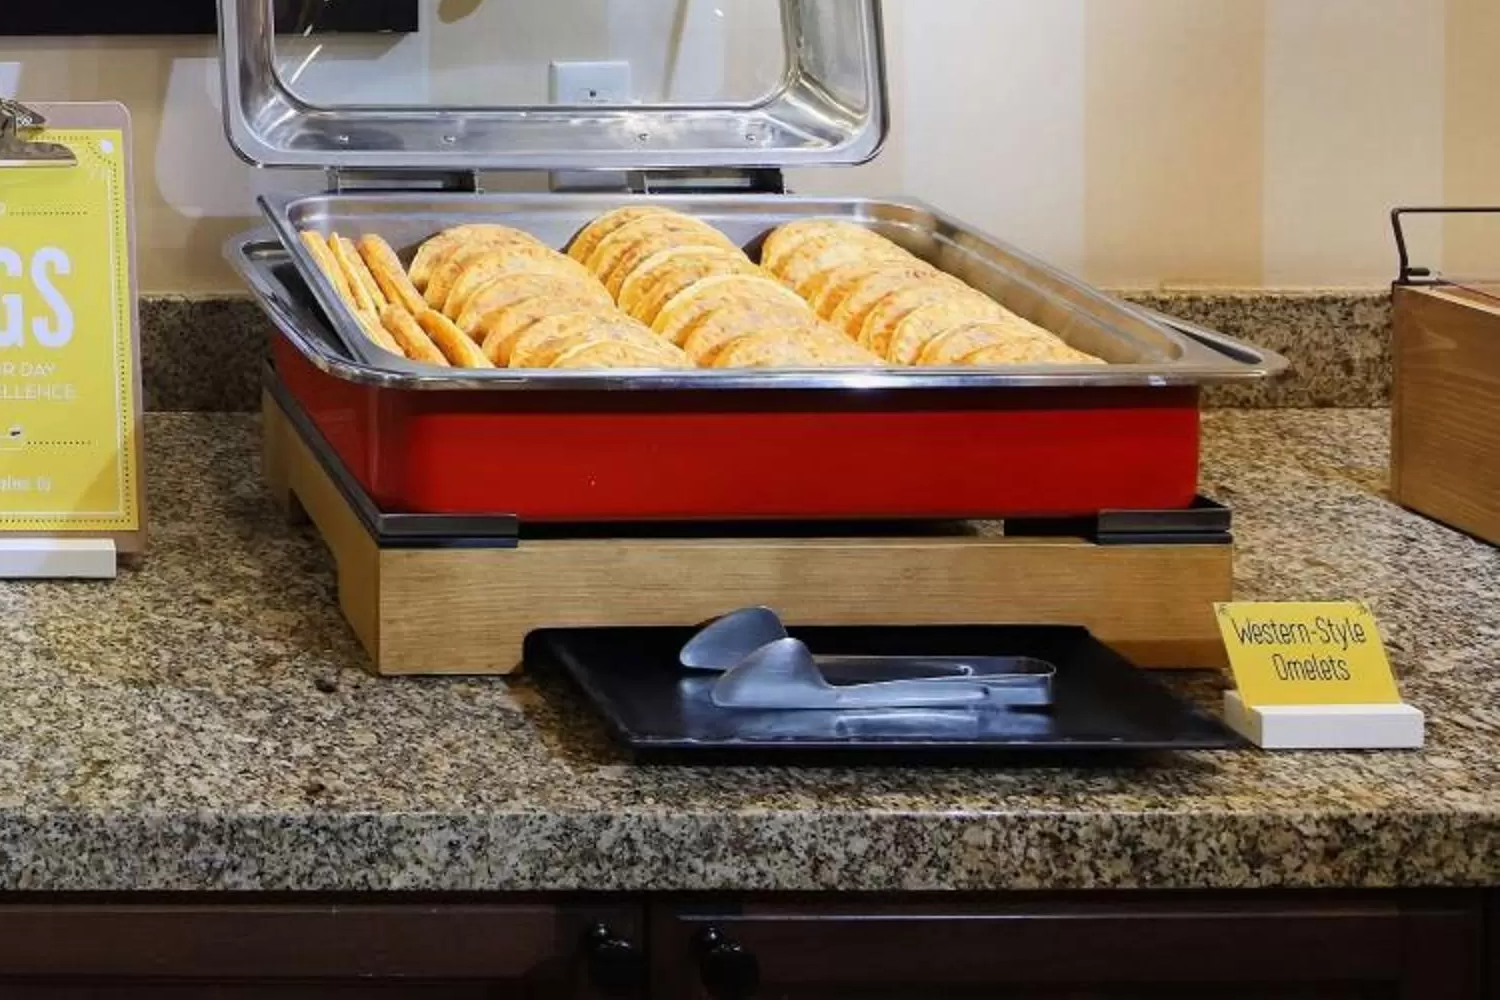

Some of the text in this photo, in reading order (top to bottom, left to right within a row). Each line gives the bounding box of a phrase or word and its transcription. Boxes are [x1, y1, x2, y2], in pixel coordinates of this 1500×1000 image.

[21, 360, 57, 377] DAY
[1231, 615, 1367, 651] Western-Style
[1271, 653, 1351, 681] Omelets
